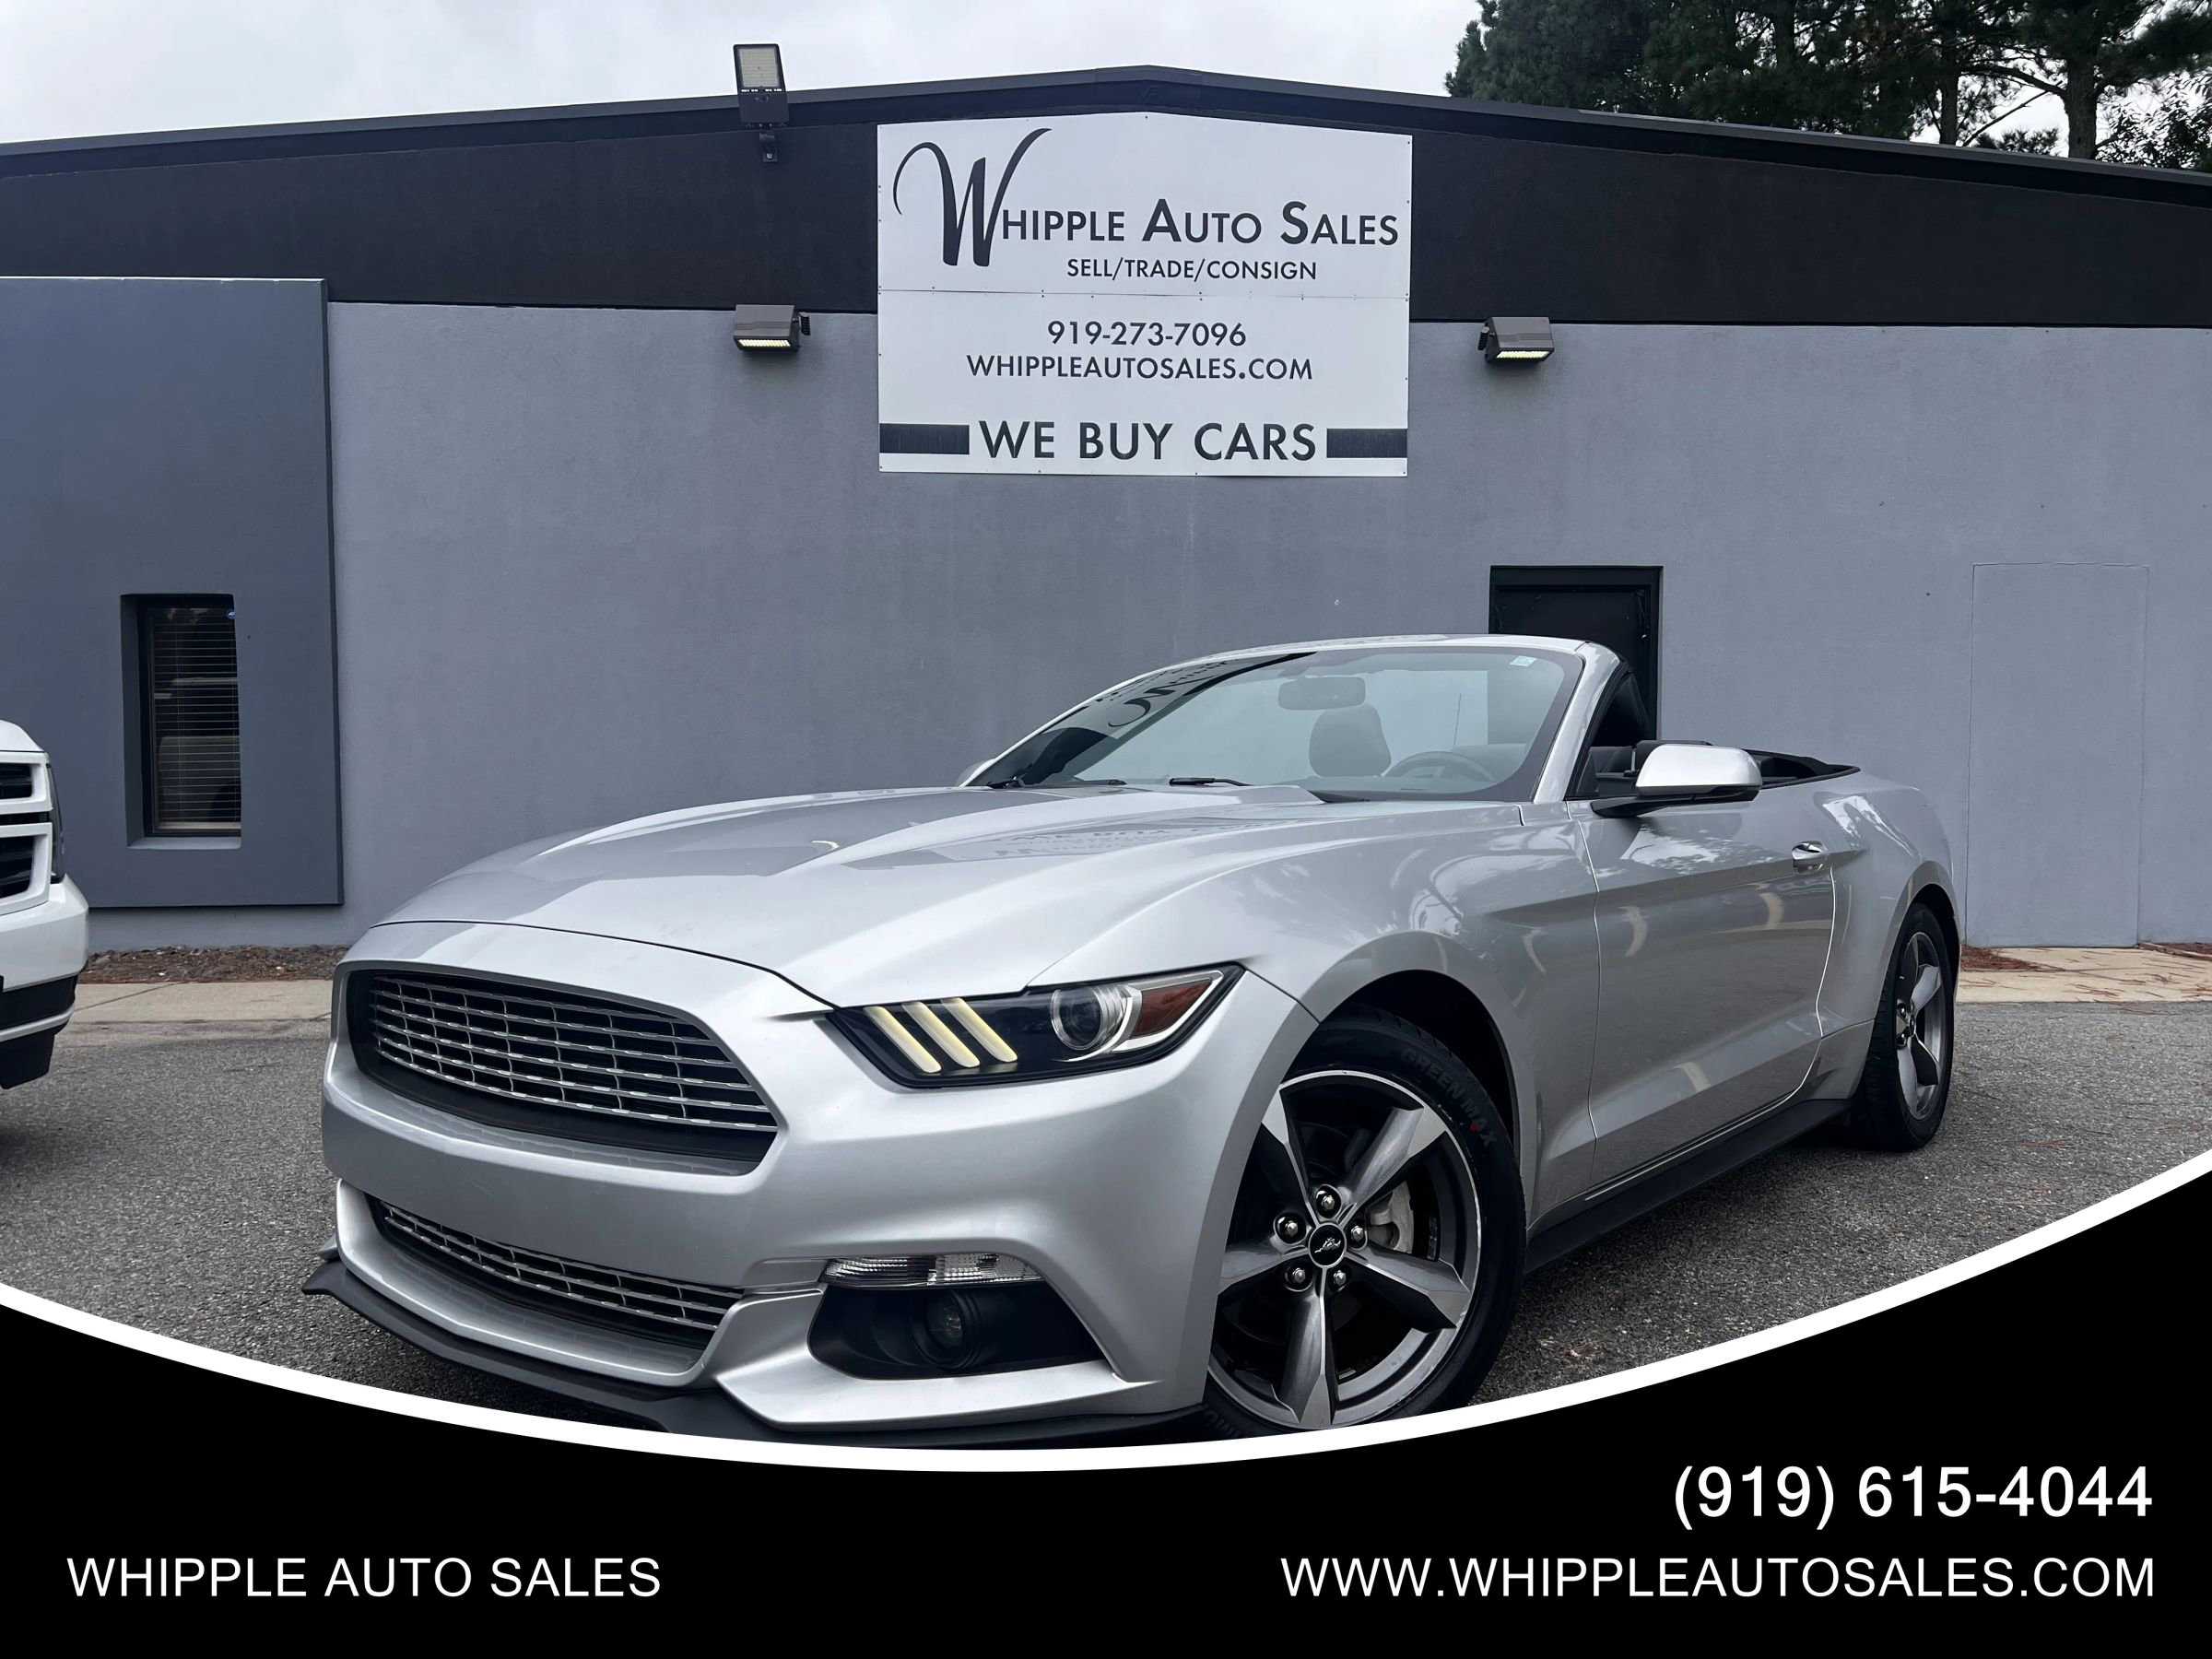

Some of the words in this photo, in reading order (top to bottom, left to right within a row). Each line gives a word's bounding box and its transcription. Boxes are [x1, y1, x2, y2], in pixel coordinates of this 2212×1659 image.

[1066, 257, 1316, 282] SELL/TRADE/CONSIGN
[1047, 320, 1246, 346] 919-273-7096
[966, 354, 1312, 380] WHIPPLEAUTOSALES.COM
[978, 420, 1055, 458] WE
[1079, 421, 1172, 460] BUY
[1194, 422, 1315, 461] CARS
[1401, 1048, 1465, 1099] GREEN
